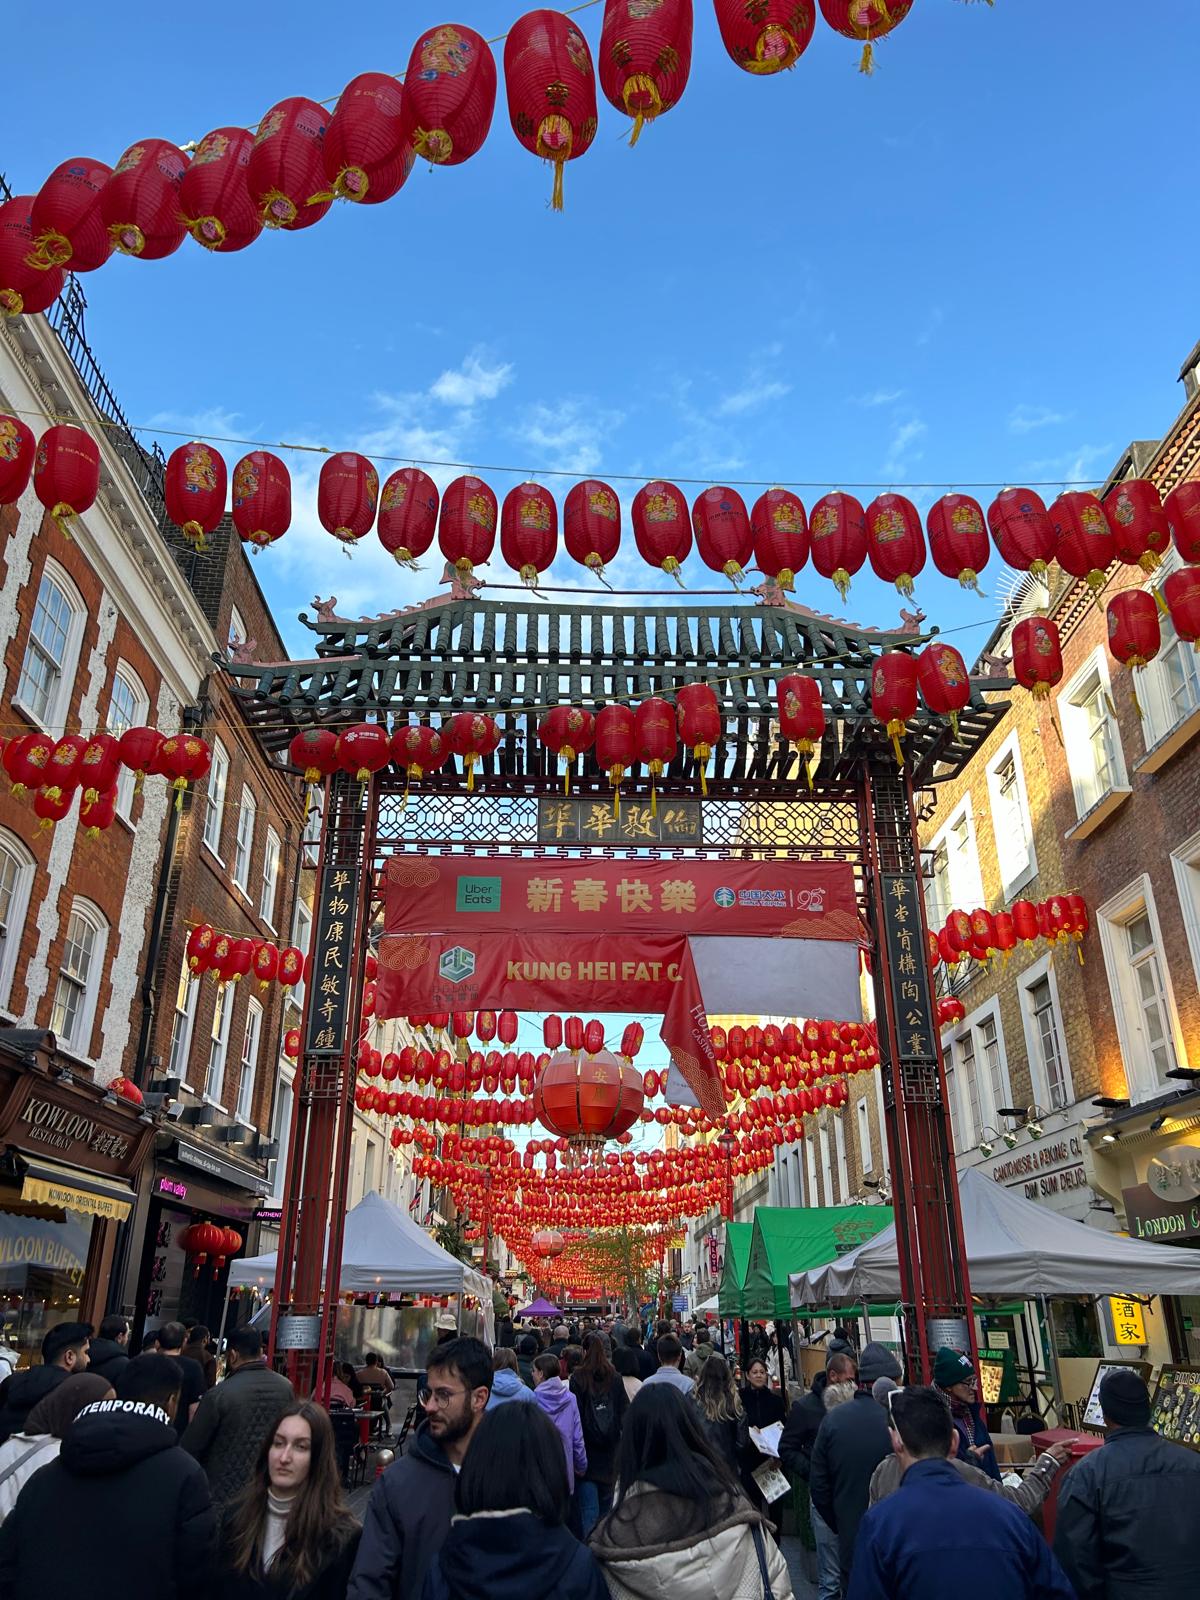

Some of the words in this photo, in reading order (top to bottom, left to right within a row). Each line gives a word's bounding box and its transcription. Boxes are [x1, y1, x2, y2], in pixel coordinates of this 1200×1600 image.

[464, 895, 492, 904] Eats
[465, 884, 492, 894] Uber
[526, 877, 697, 913] 新春快樂
[507, 961, 572, 981] KUNG
[578, 962, 616, 981] HEI
[622, 962, 662, 981] FAT
[691, 1028, 715, 1060] CASINO
[21, 1097, 98, 1143] KOWLOON
[28, 1126, 74, 1152] RESTAURANT
[993, 1153, 1033, 1182] CANTONESE
[1033, 1152, 1039, 1169] &
[1040, 1142, 1068, 1166] PEKING
[48, 1188, 75, 1203] KOWLOON
[75, 1195, 97, 1209] ORIENTAL
[97, 1200, 113, 1213] BUFFET
[1024, 1181, 1037, 1199] DIM
[1041, 1177, 1058, 1196] SUM
[1135, 1213, 1186, 1238] LONDON
[45, 1240, 86, 1288] BUFFET
[1116, 1302, 1141, 1341] 酒家
[1174, 1371, 1190, 1385] DIM
